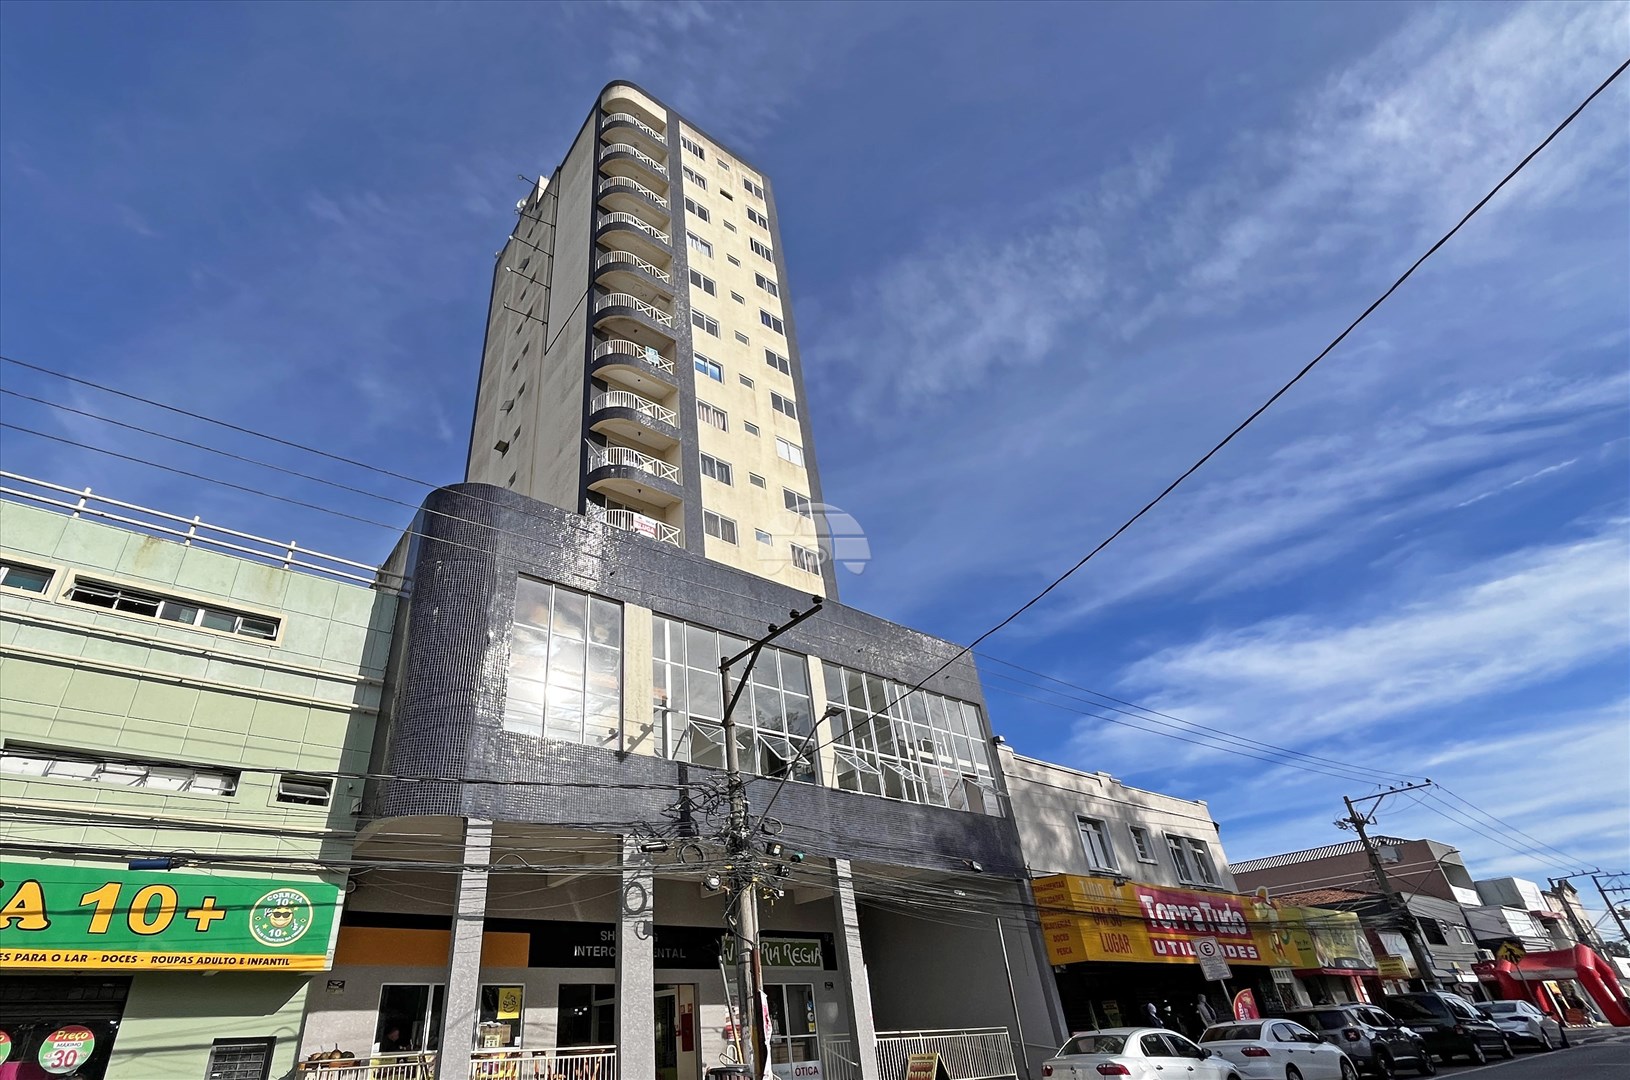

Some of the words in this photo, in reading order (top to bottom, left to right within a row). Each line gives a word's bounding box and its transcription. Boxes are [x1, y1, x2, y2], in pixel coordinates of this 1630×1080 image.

[267, 892, 304, 904] CORREIA
[0, 879, 51, 930] A
[79, 882, 227, 935] 10+
[1099, 932, 1132, 954] LUGAR
[1203, 944, 1212, 954] E
[14, 953, 47, 962] PARA
[51, 954, 61, 962] O
[64, 954, 88, 963] LAR
[101, 954, 138, 964] DOCES
[150, 956, 194, 964] ROUPAS
[196, 957, 237, 965] ADULTO
[247, 958, 290, 966] INFANTIL
[726, 942, 781, 966] VRIA
[783, 943, 822, 966] REGIA
[55, 1030, 89, 1041] Preço
[51, 1049, 78, 1068] 30
[795, 1065, 819, 1077] ÓTICA
